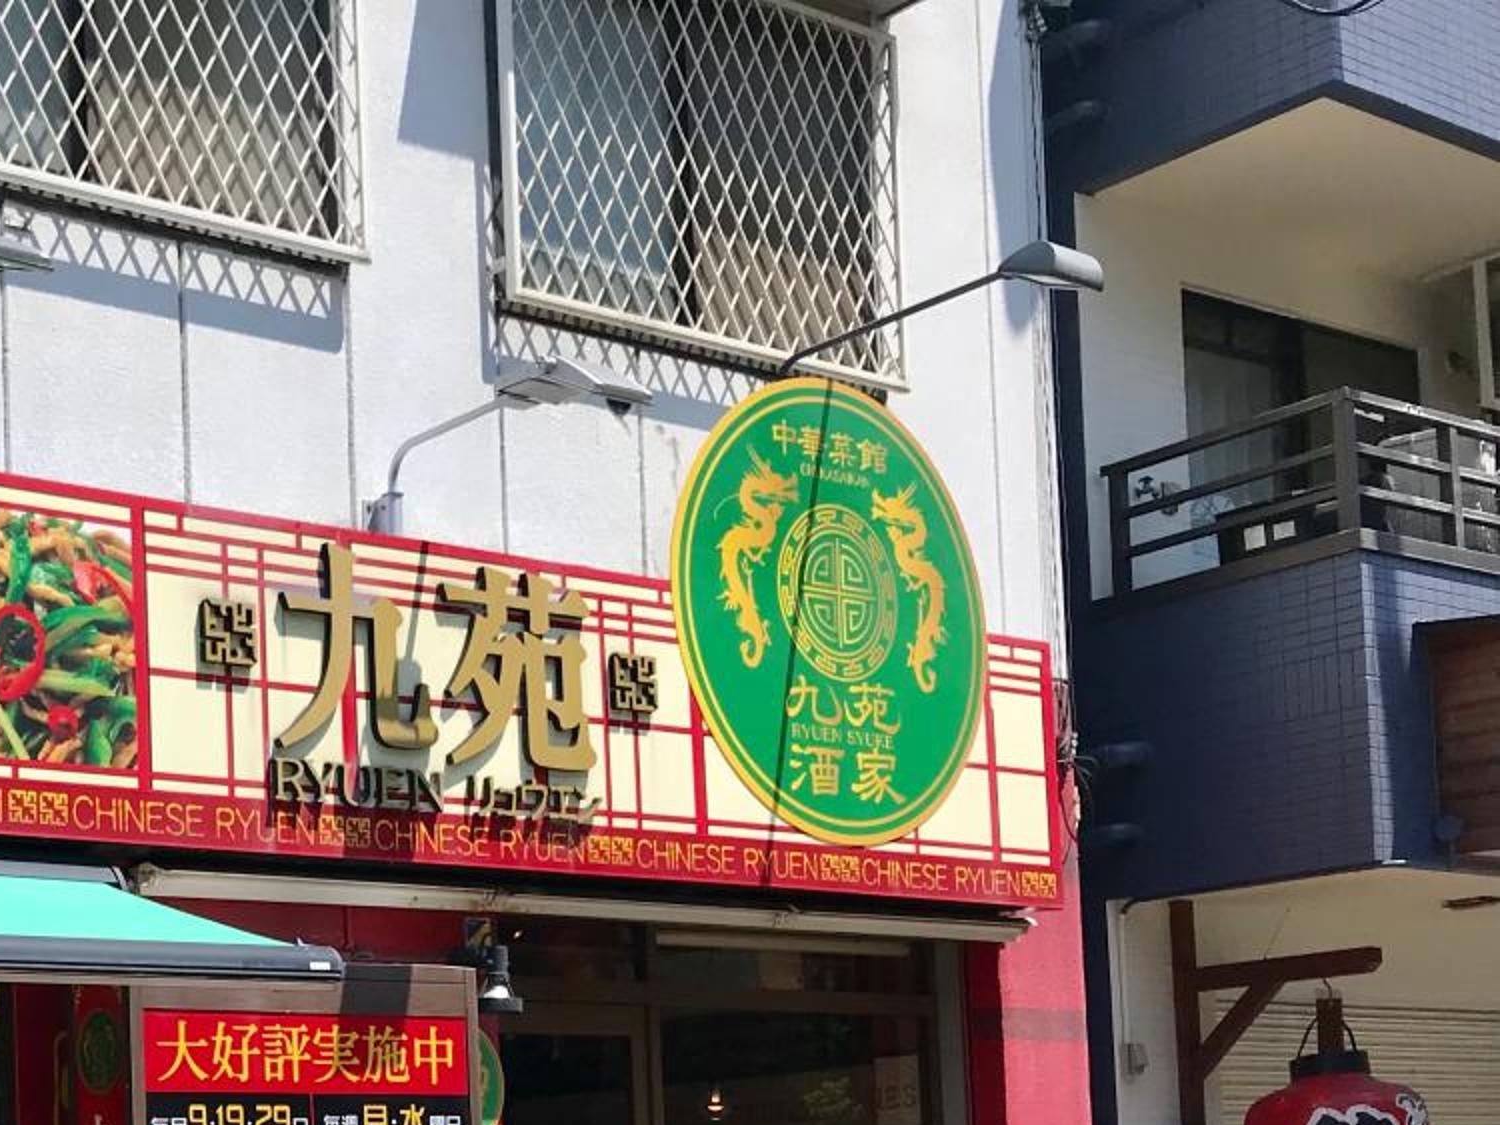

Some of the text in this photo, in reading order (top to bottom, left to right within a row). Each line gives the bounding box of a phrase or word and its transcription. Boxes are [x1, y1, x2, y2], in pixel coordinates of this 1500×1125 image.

[771, 418, 889, 475] 中華菜館
[274, 541, 598, 772] 九苑
[786, 674, 902, 736] 九苑
[791, 723, 843, 745] RYUEN
[270, 757, 442, 814] RYUEN
[788, 743, 905, 804] 酒家
[73, 795, 204, 838] CHINESE
[217, 806, 317, 846] RYUEN
[375, 817, 488, 857] CHINESE
[500, 826, 587, 863] RYUEN
[637, 840, 736, 875] CHINESE
[743, 847, 820, 882] RYUEN
[862, 857, 950, 888] CHINESE
[955, 865, 1022, 897] RYUEN
[156, 1019, 455, 1086] 大好評実施中
